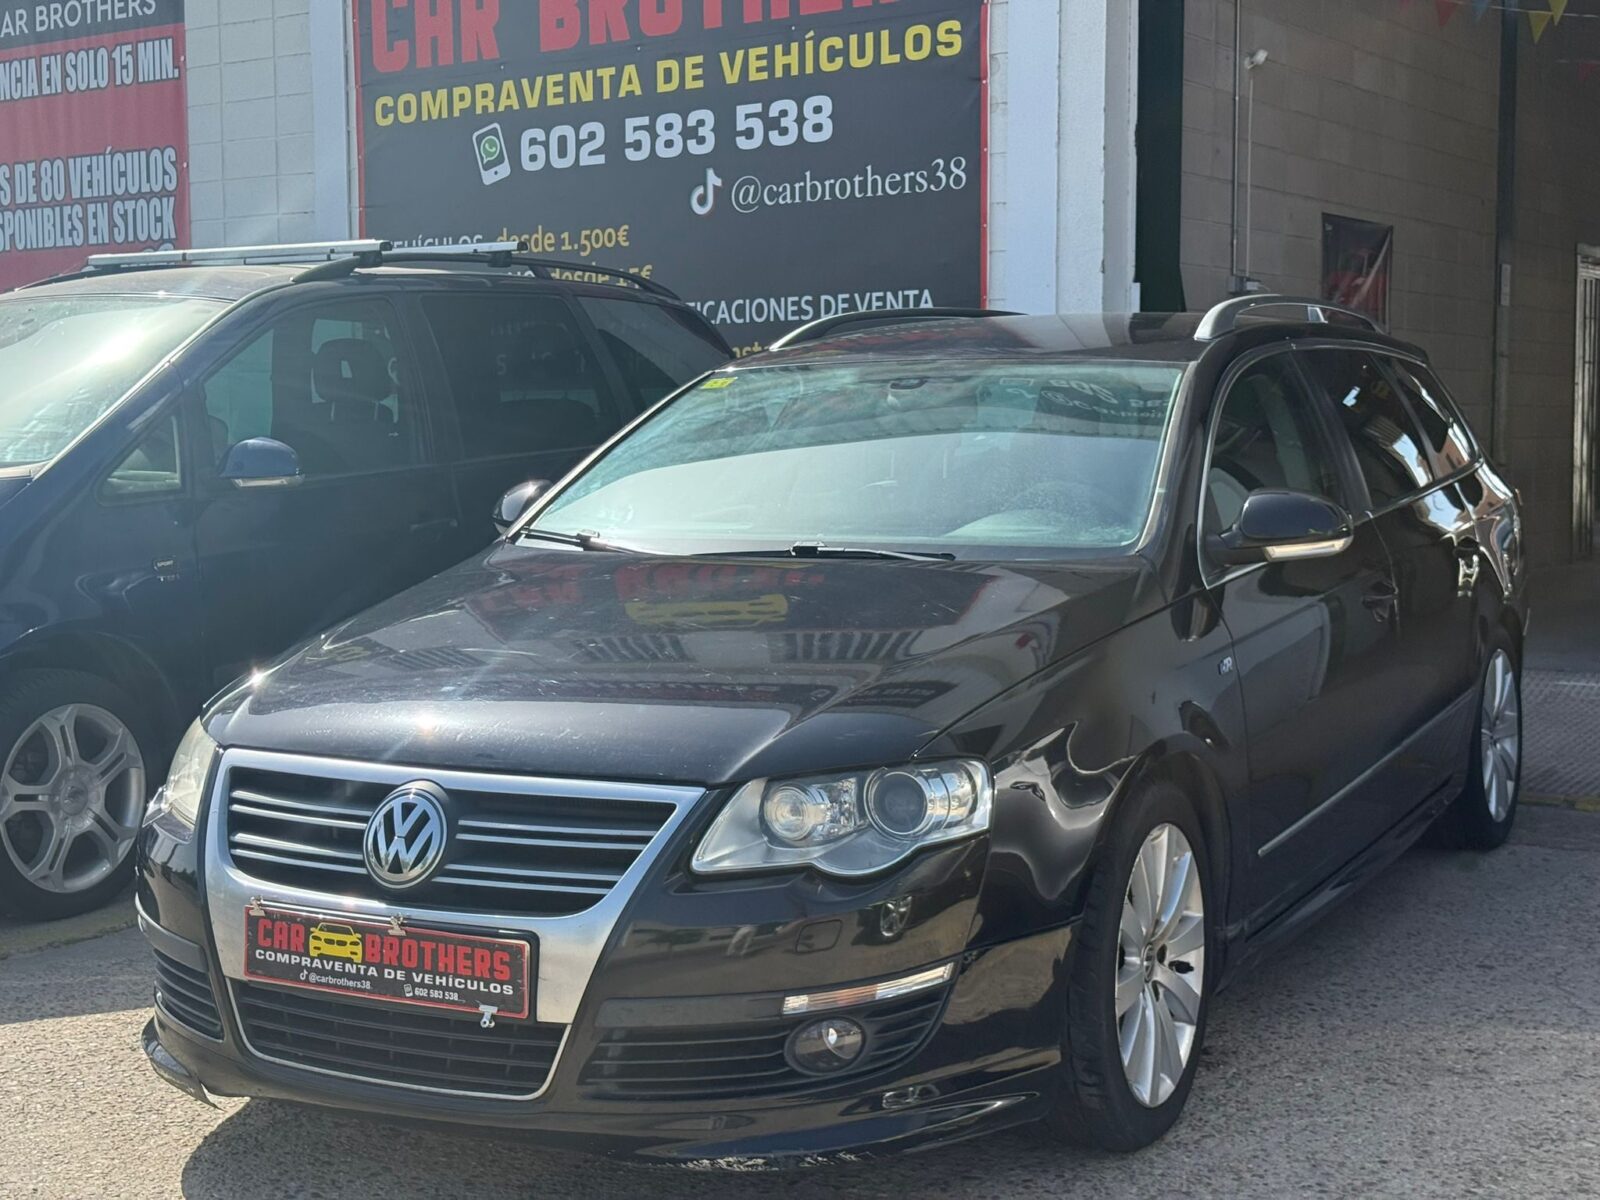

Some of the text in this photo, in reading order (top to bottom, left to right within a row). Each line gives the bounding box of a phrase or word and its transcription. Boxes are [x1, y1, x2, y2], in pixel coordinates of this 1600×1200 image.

[35, 0, 157, 32] BROTHERS
[372, 0, 500, 73] CAR
[41, 55, 62, 95] EN
[65, 47, 109, 92] SOLO
[112, 44, 134, 86] 15
[137, 38, 179, 83] MIN.
[374, 64, 642, 127] COMPRAVENTA
[656, 55, 705, 93] DE
[719, 19, 963, 85] VEHÍCULOS
[520, 95, 834, 172] 602 583 538
[14, 161, 37, 204] DE
[40, 158, 66, 202] 80
[68, 145, 177, 199] VEHÍCULOS
[731, 156, 967, 213] @carbrothers38
[87, 202, 109, 245] EN
[112, 197, 176, 244] STOCK
[560, 225, 630, 256] 1.500€
[854, 288, 934, 312] VENTA
[255, 949, 514, 995] COMPRAVENTA DE VEHÍCULOS
[257, 918, 511, 981] CAR BROTHERS
[309, 972, 371, 990] @carbrothers38
[414, 986, 459, 1001] 602 583 538
